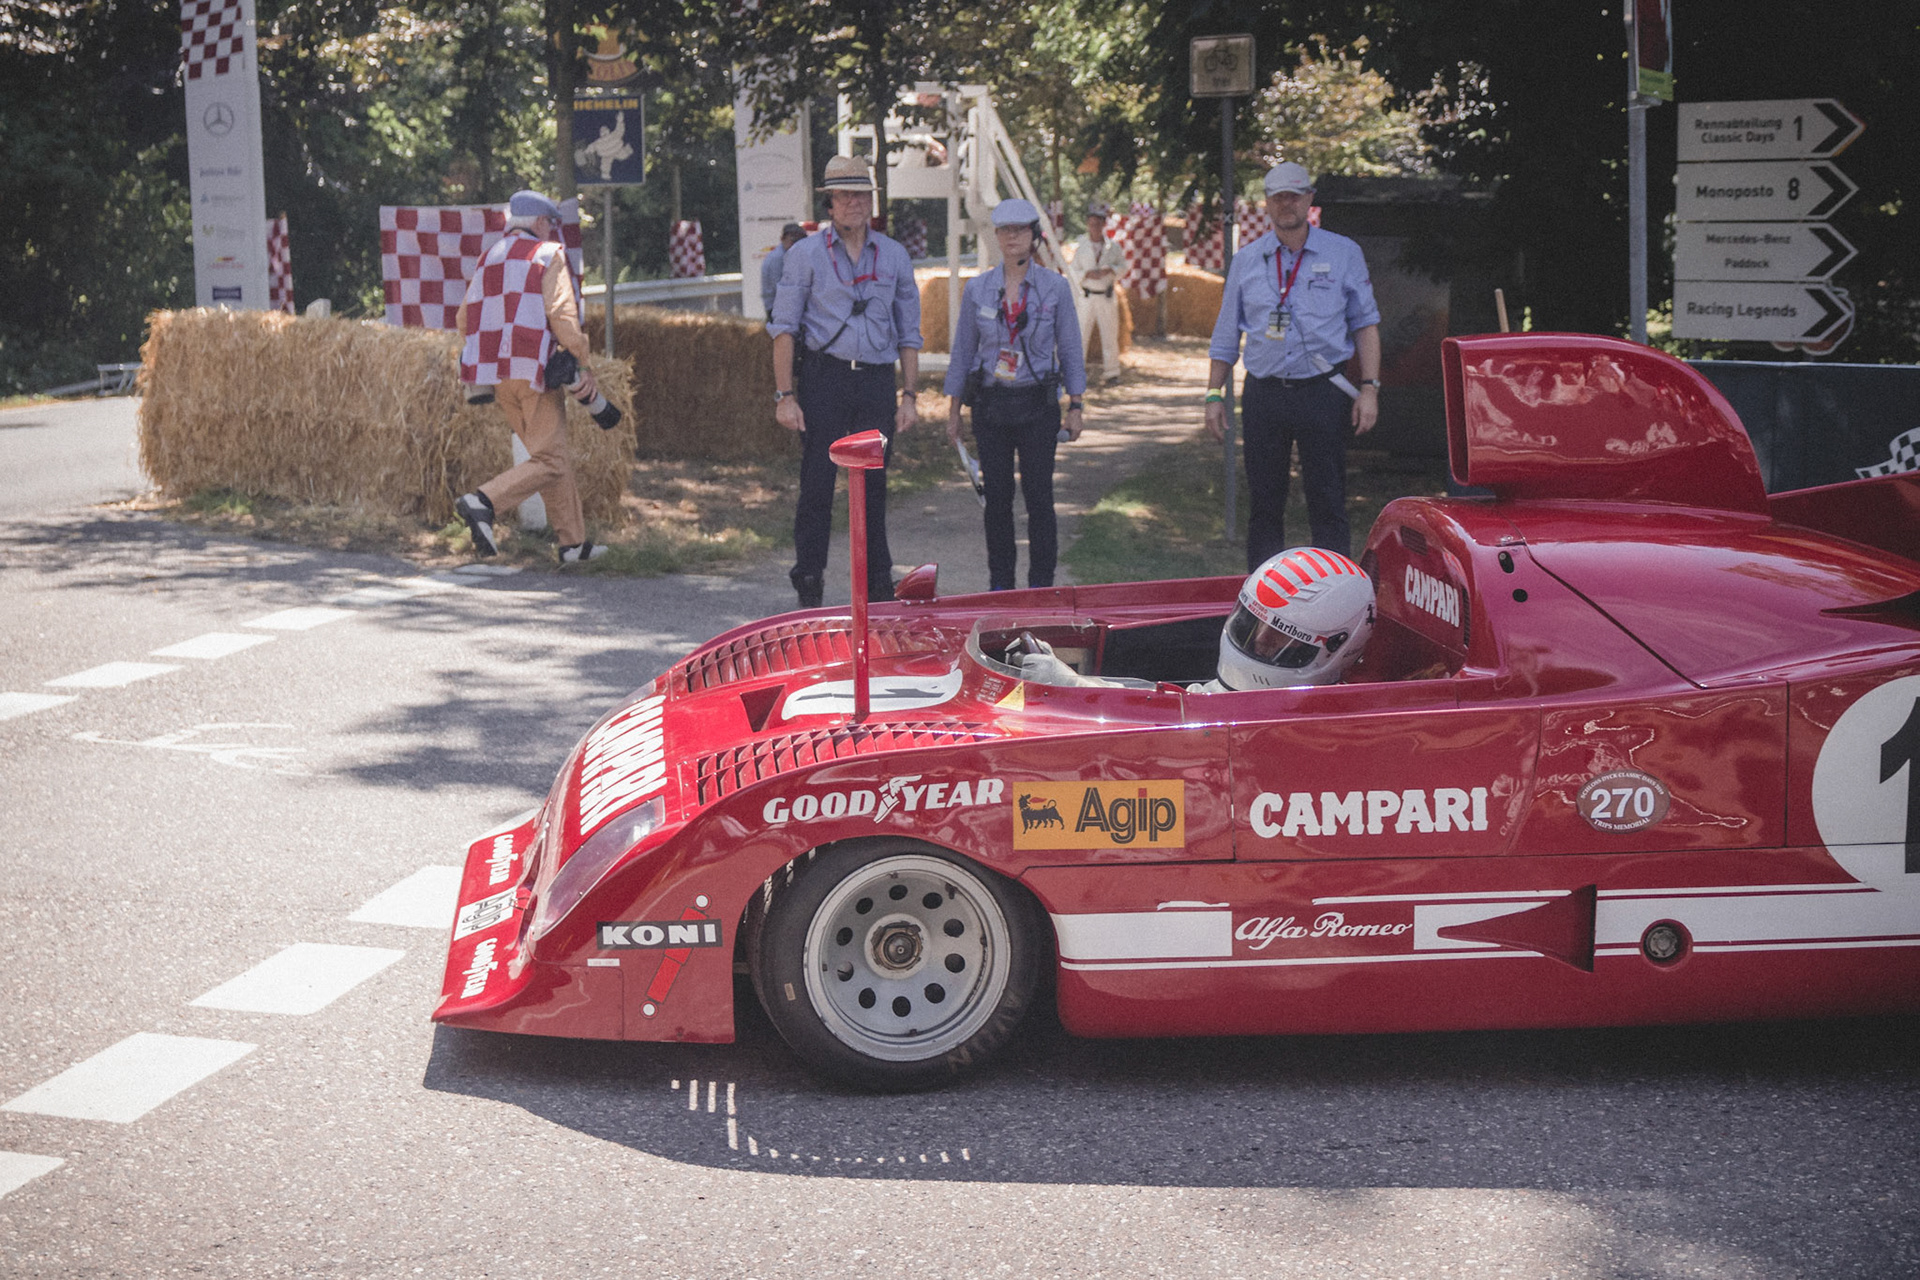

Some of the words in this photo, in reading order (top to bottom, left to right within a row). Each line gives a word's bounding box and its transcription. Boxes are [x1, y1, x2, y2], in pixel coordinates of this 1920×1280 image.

[1695, 118, 1782, 130] Rennabteilung
[1793, 116, 1803, 141] 1
[1701, 132, 1742, 143] Classic
[1746, 131, 1775, 143] Days
[1696, 186, 1774, 200] Monoposto
[1788, 177, 1800, 200] 8
[1706, 234, 1791, 244] Mercedes-Benz
[1725, 258, 1769, 268] Paddock
[1687, 302, 1733, 318] Racing
[1737, 304, 1797, 319] Legends
[1404, 564, 1460, 628] CAMPARI
[1270, 615, 1312, 642] Marlboro
[579, 695, 668, 836] CAMPARI
[1618, 772, 1641, 780] CLASSIC
[1248, 786, 1489, 839] CAMPARI
[1590, 786, 1655, 819] 270
[1075, 787, 1177, 844] Agip
[1594, 818, 1613, 829] TRIPS
[1613, 817, 1651, 830] MEMORIAL
[602, 923, 717, 946] KONI
[1234, 916, 1308, 951] Alfa
[1310, 911, 1413, 938] Romeo
